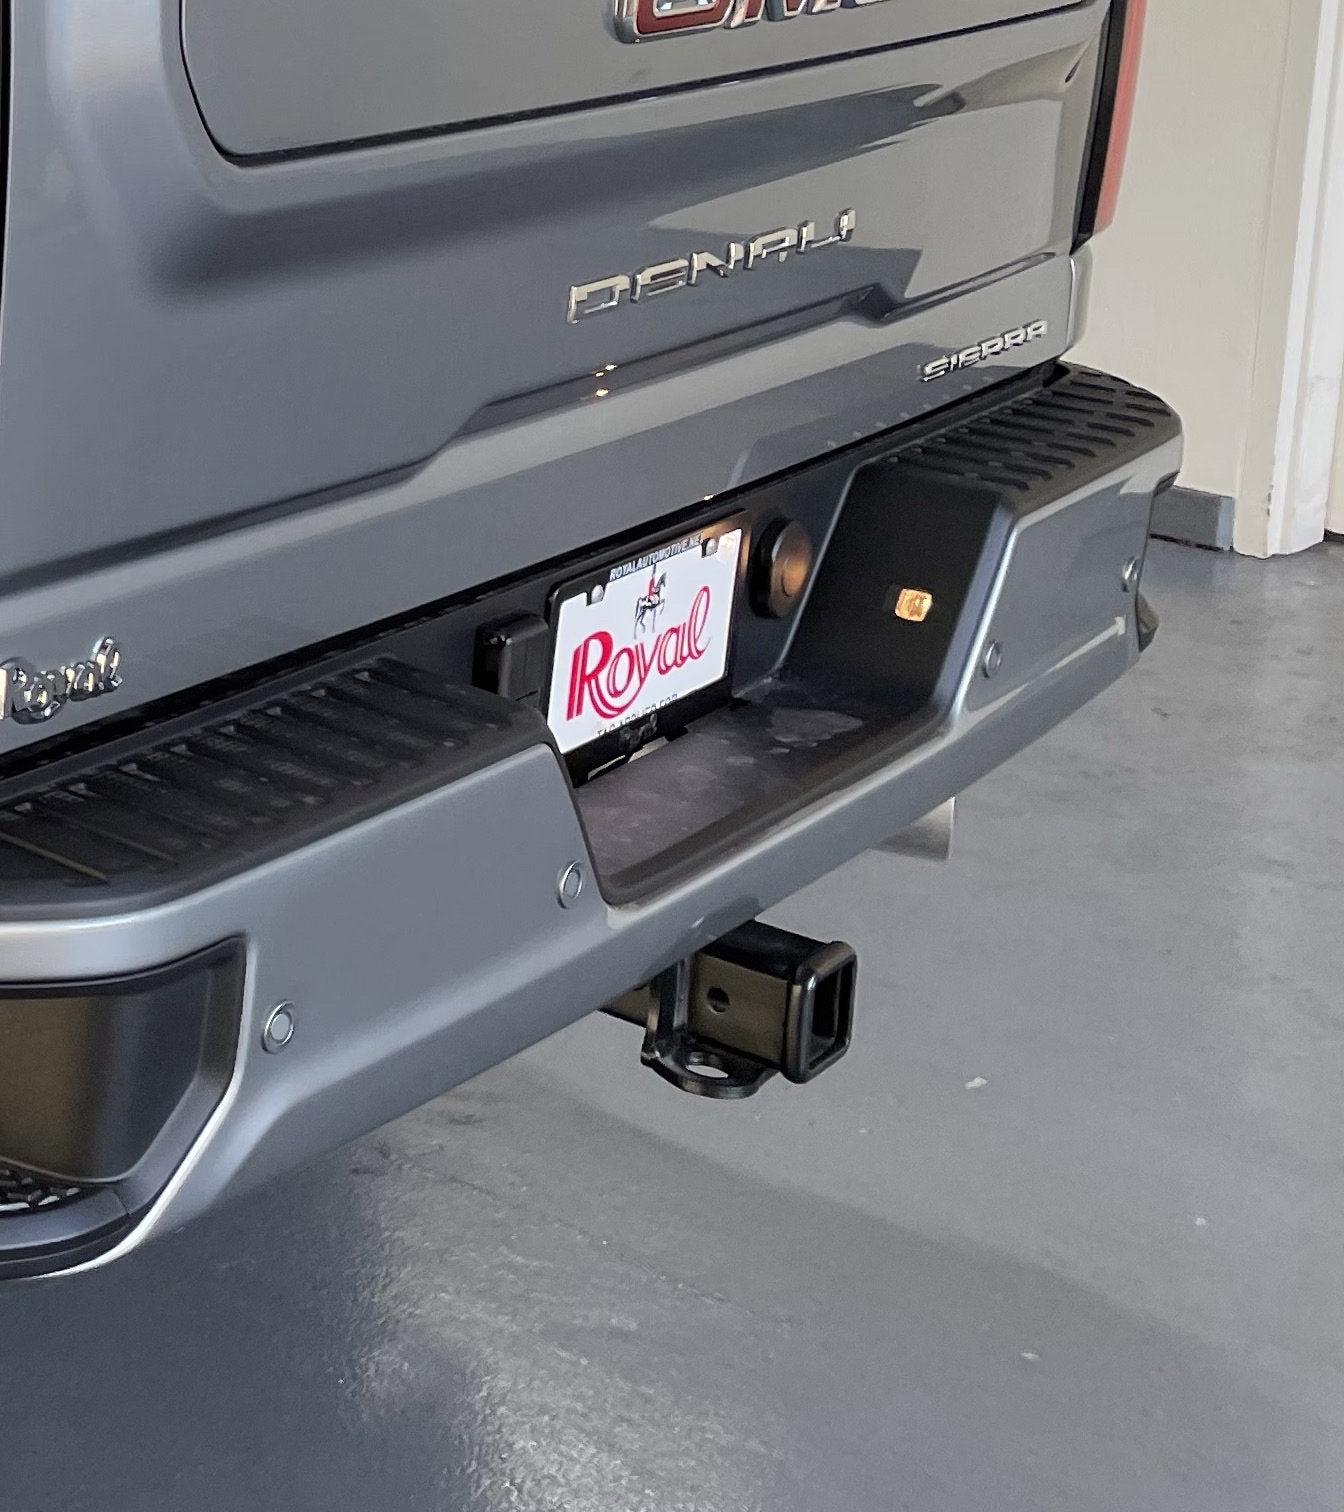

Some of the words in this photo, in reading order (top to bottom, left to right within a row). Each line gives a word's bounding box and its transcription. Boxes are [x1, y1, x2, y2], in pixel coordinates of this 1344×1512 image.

[567, 208, 857, 324] DENALI
[919, 319, 1048, 382] SIERRA
[566, 586, 711, 720] Royal
